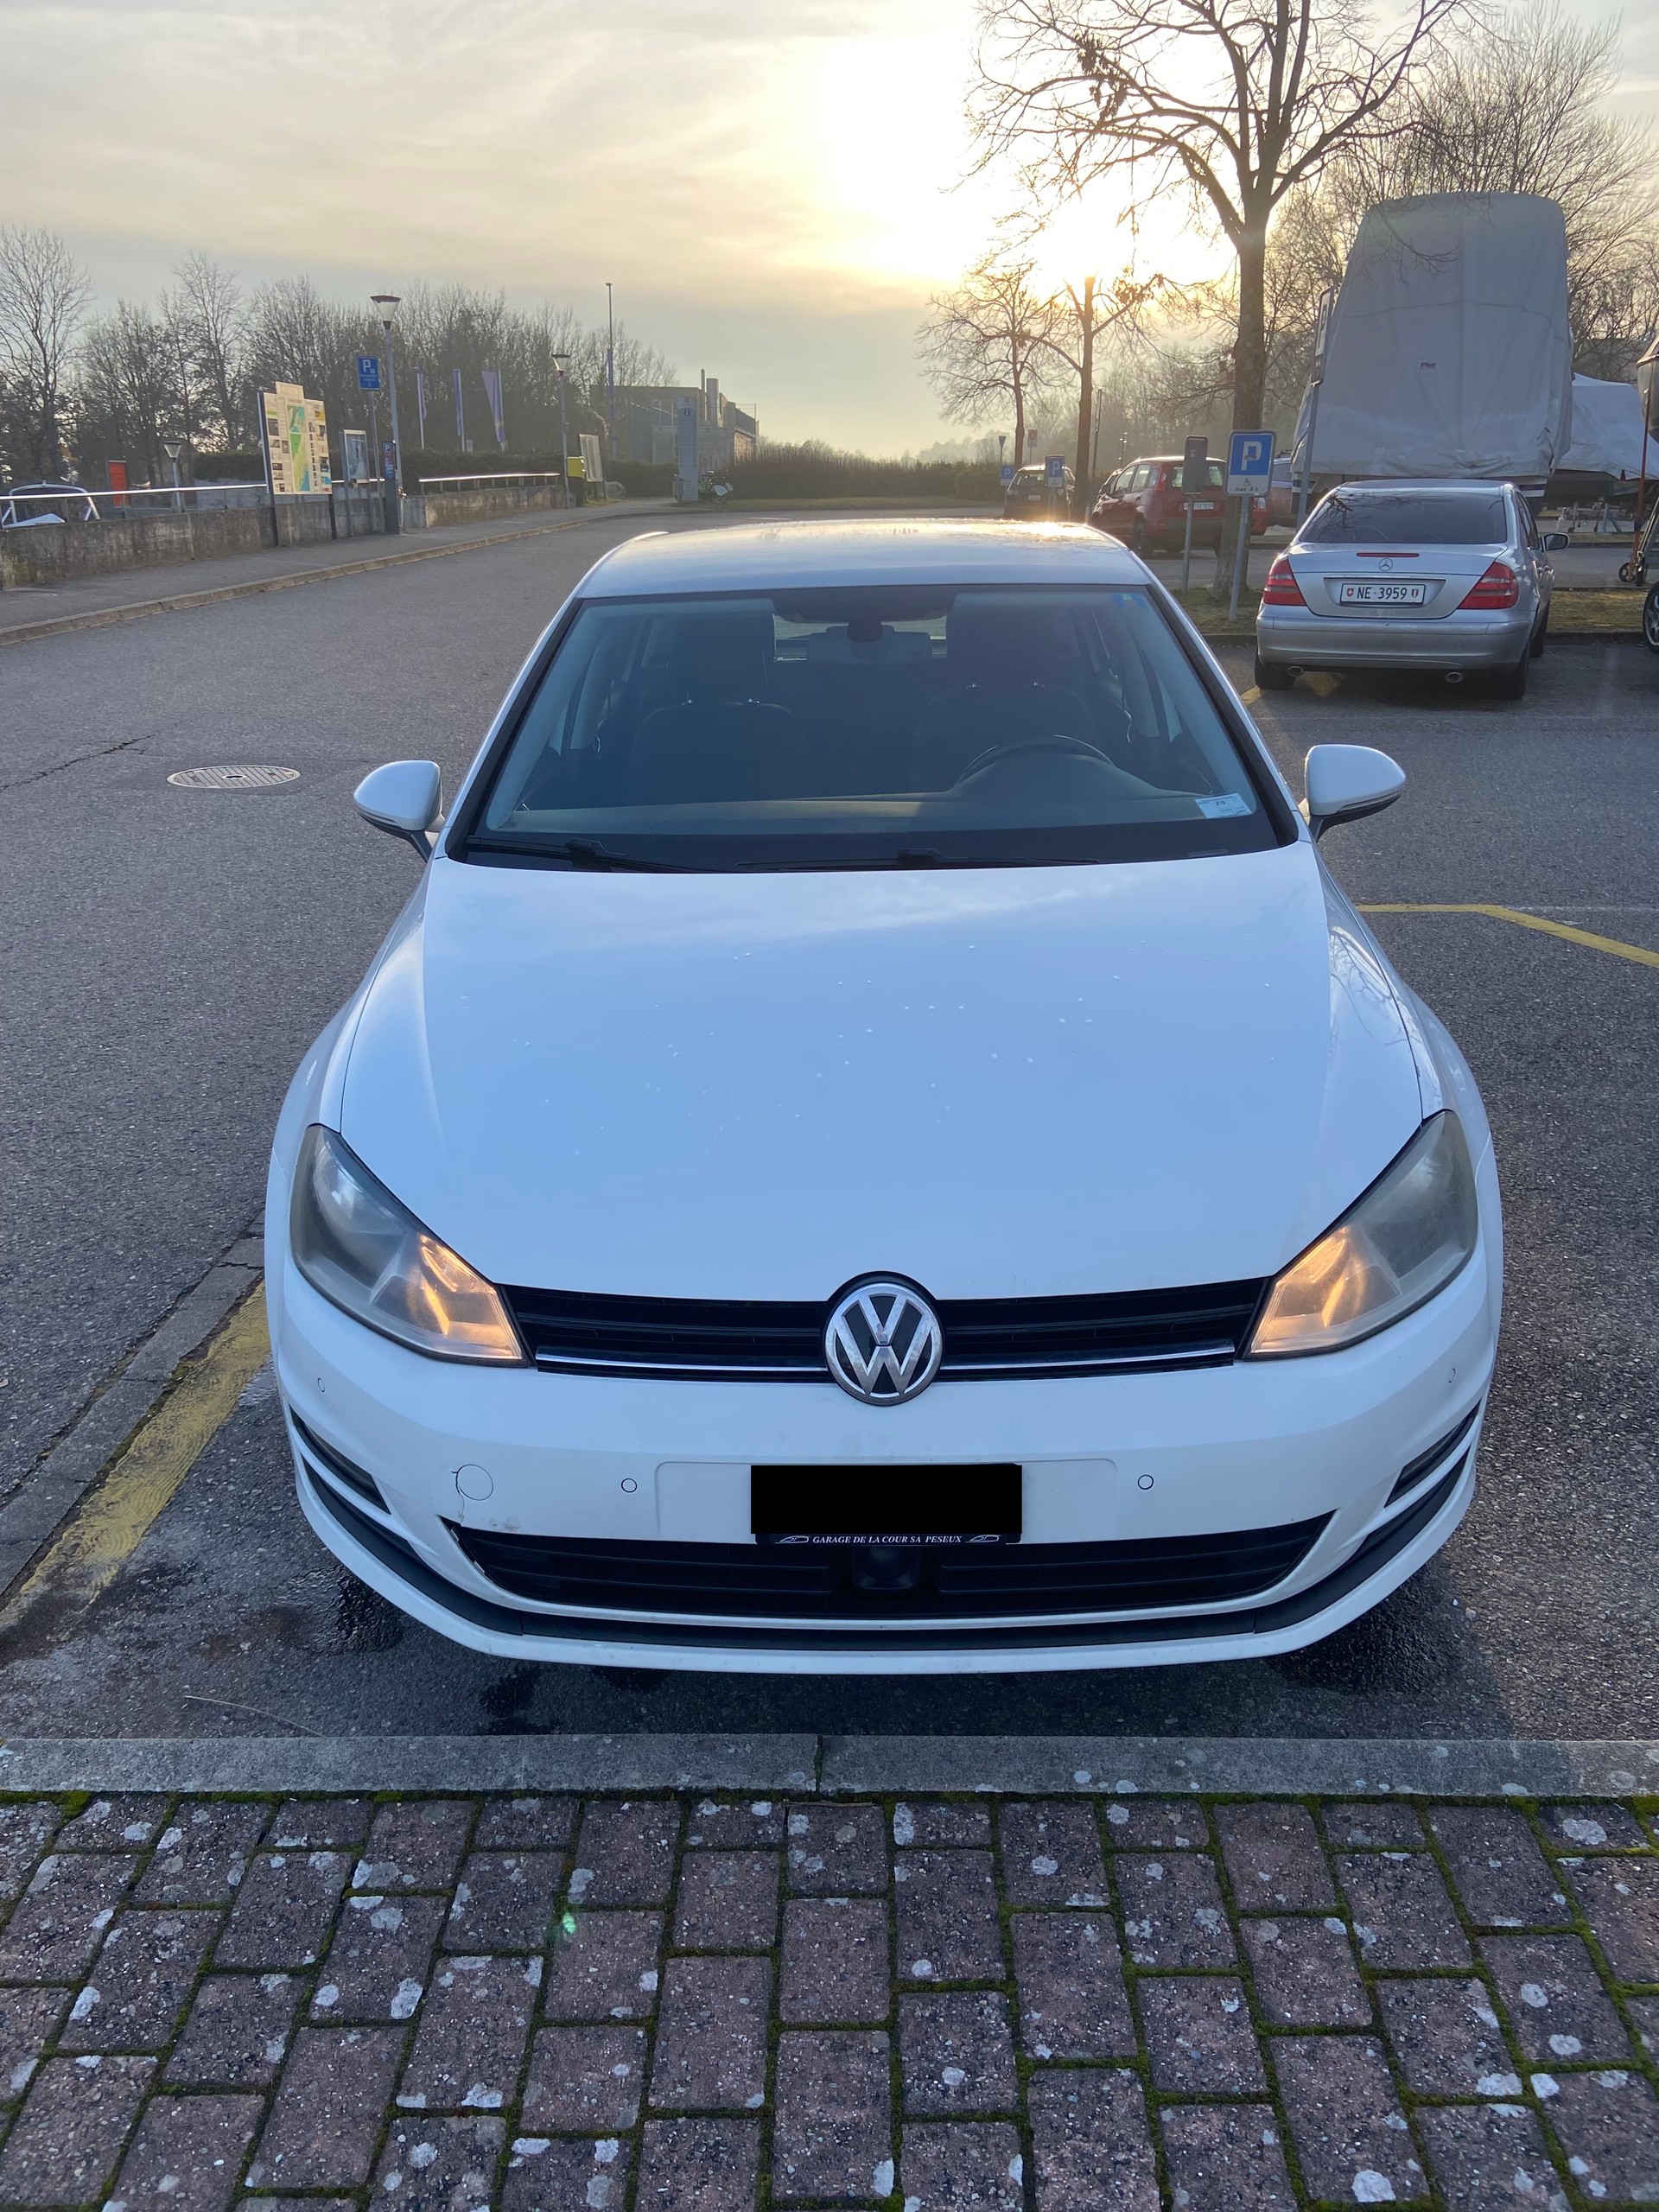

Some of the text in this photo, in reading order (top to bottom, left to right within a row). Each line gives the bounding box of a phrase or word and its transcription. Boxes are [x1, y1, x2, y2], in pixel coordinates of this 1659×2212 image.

[362, 359, 372, 372] P
[1241, 441, 1262, 471] P
[1004, 467, 1011, 478] P
[1052, 461, 1060, 476] P
